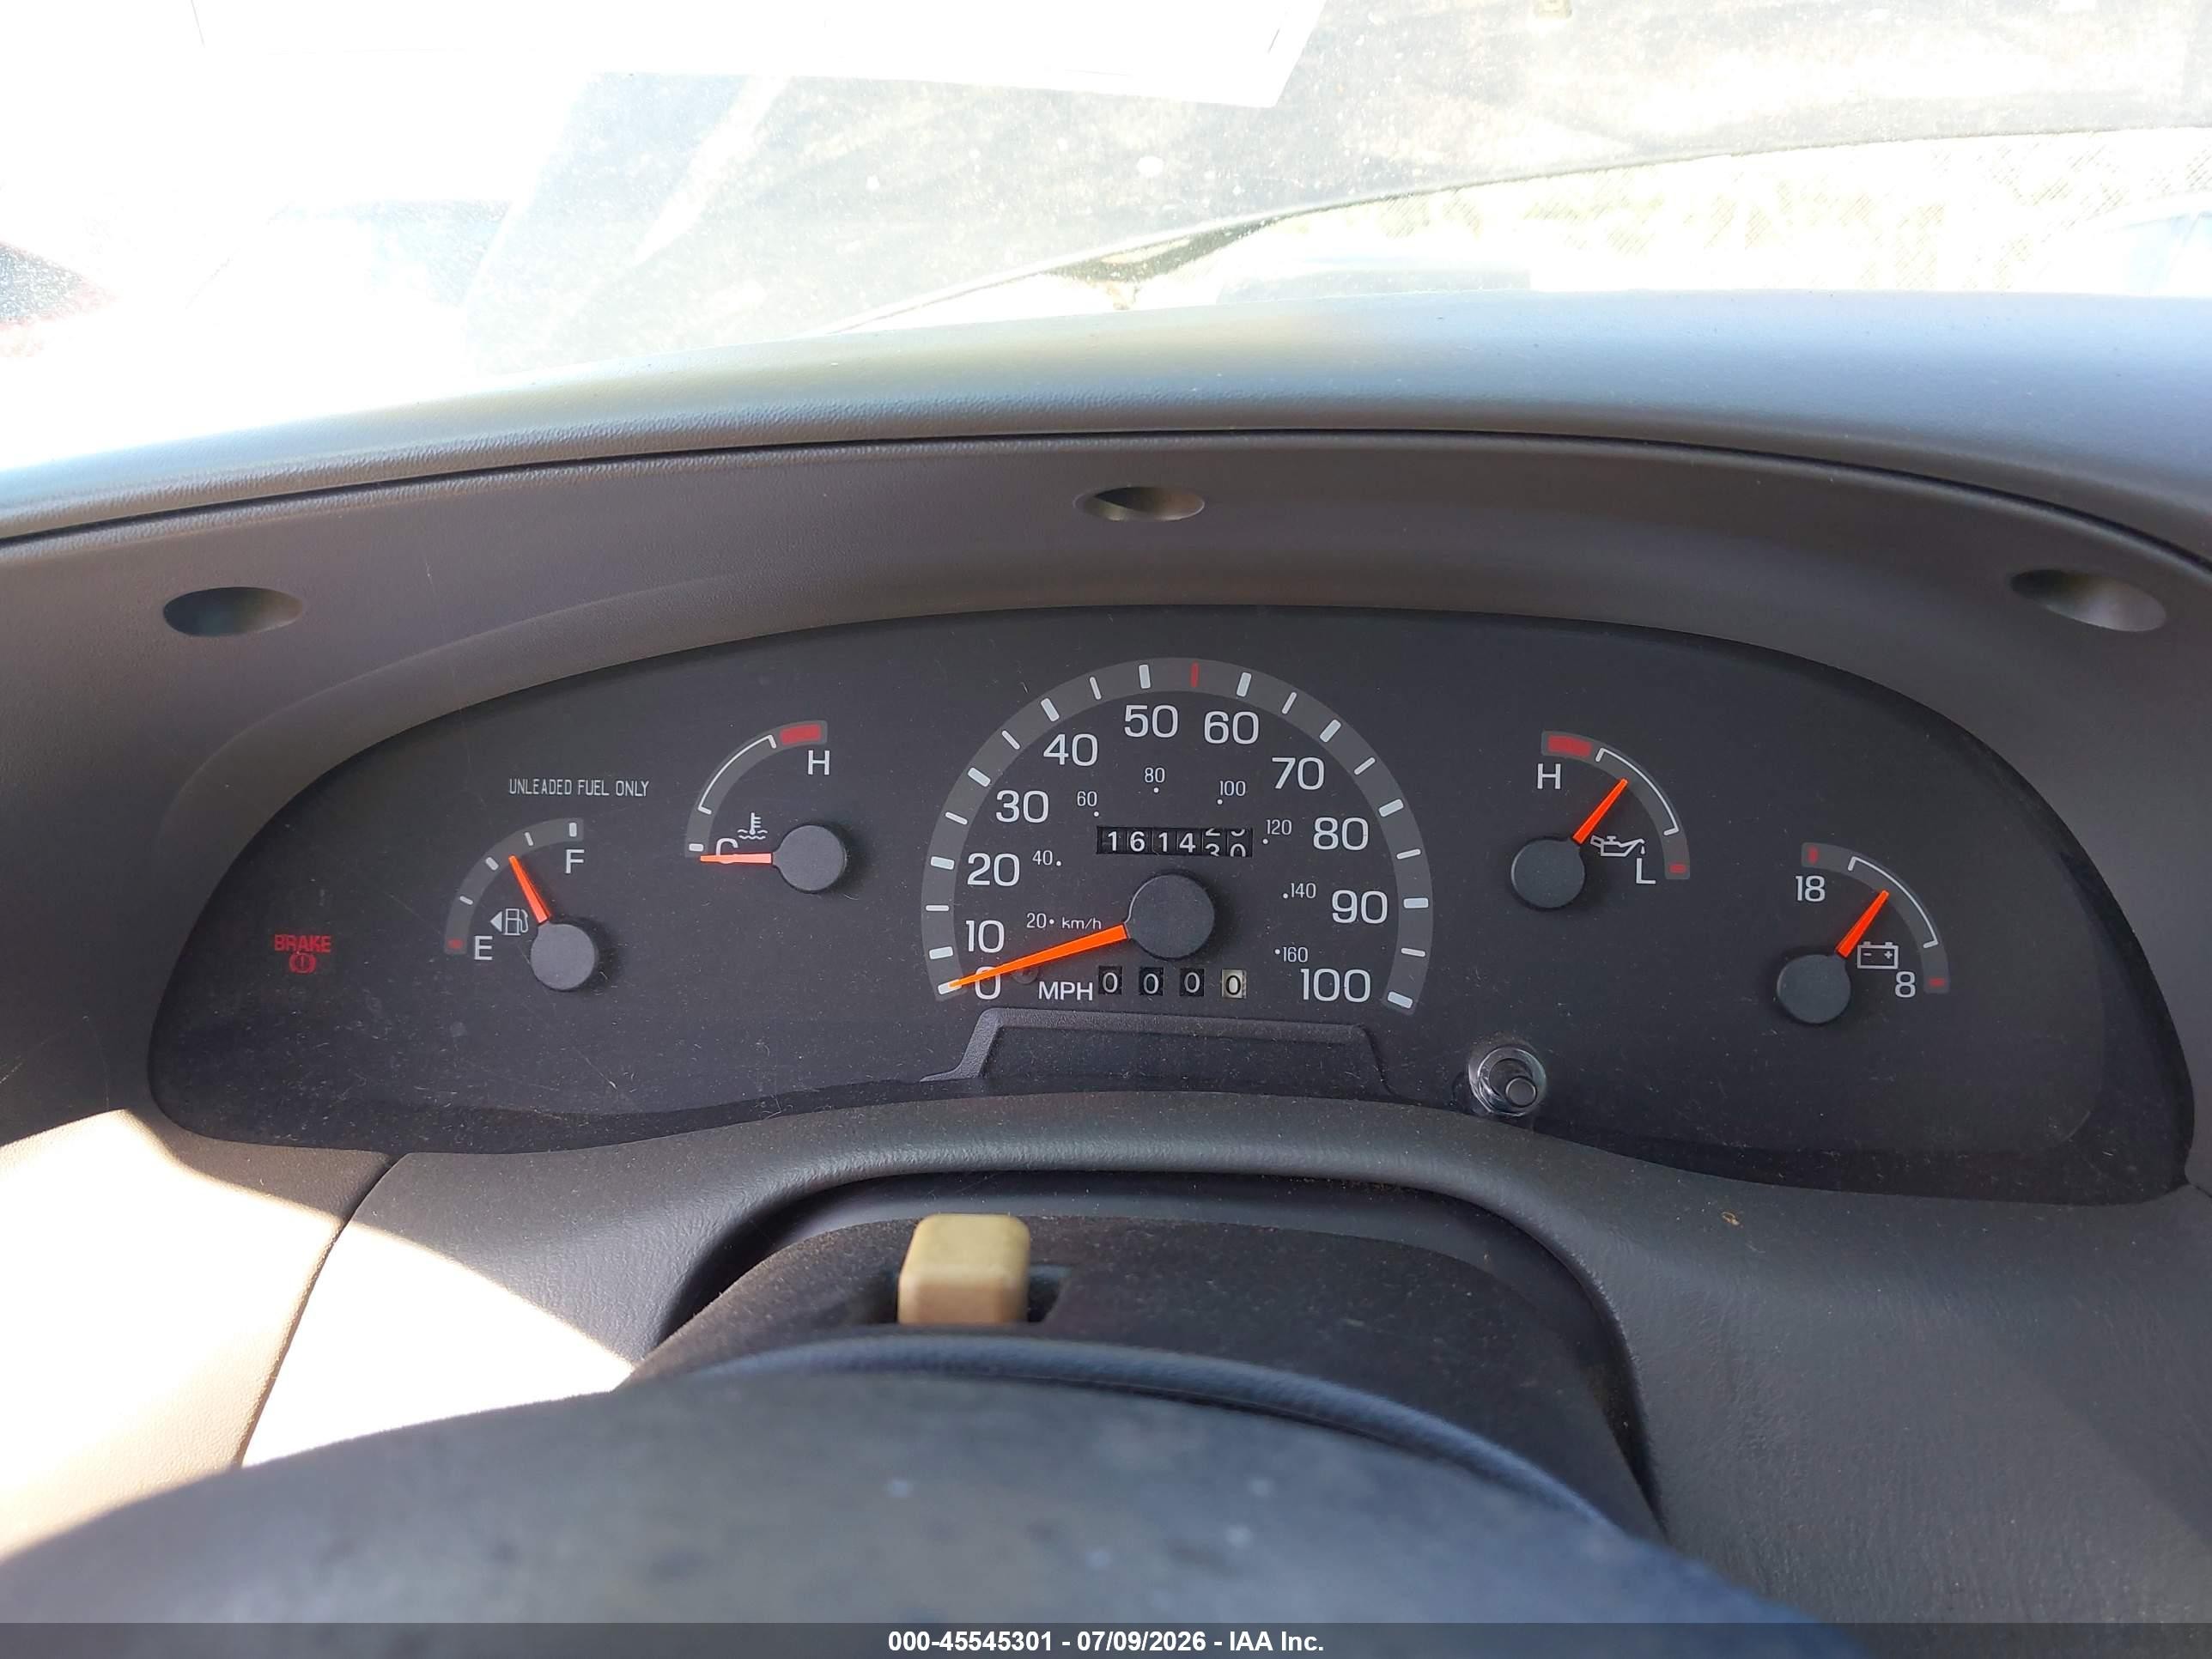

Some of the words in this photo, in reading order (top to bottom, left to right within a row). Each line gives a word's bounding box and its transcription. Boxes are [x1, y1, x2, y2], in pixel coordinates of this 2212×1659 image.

[1124, 704, 1178, 738] 50
[1204, 711, 1259, 744] 60
[807, 750, 830, 775] H
[1042, 733, 1098, 767] 40
[1145, 767, 1165, 783] 80
[1272, 757, 1324, 790] 70
[1537, 763, 1561, 790] H
[509, 778, 572, 795] UNLEADED
[578, 779, 610, 796] FUEL
[616, 780, 649, 797] ONLY
[1077, 791, 1097, 807] 60
[1219, 781, 1246, 797] 100
[995, 790, 1049, 823] 30
[1267, 819, 1292, 836] 120
[1313, 817, 1369, 851] 80
[565, 848, 585, 874] F
[967, 853, 1020, 887] 20
[1032, 850, 1053, 866] 40
[1636, 857, 1656, 884] L
[1291, 883, 1316, 899] 140
[1795, 875, 1826, 902] 18
[1026, 912, 1047, 928] 20
[1332, 890, 1388, 924] 90
[1061, 916, 1102, 930] km/h
[274, 933, 331, 953] BRAKE
[474, 935, 493, 961] E
[965, 920, 1005, 953] 10
[1283, 946, 1309, 963] 160
[1038, 981, 1093, 1001] MPH
[1300, 968, 1370, 1003] 100
[1894, 970, 1916, 998] 8
